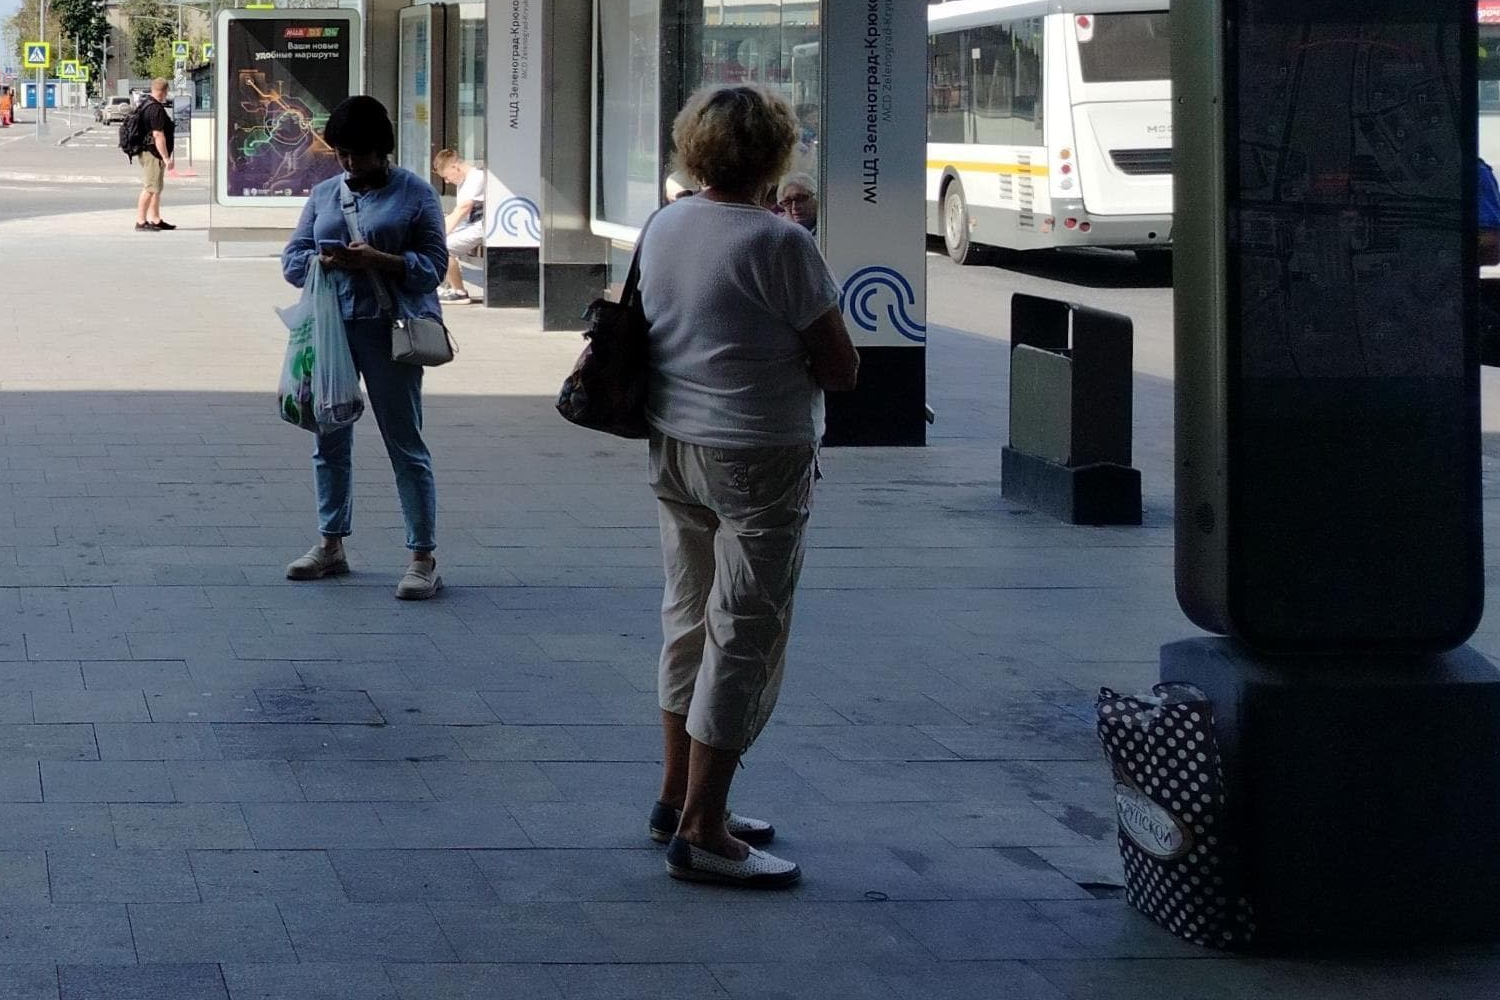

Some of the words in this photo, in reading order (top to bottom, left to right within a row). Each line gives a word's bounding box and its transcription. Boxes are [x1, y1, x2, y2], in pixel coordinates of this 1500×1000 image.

[255, 50, 293, 61] удобные
[295, 51, 339, 60] маршруты
[287, 41, 310, 50] Ваши
[509, 101, 520, 130] МЦД
[882, 94, 893, 122] MCD
[864, 157, 879, 204] МЦД
